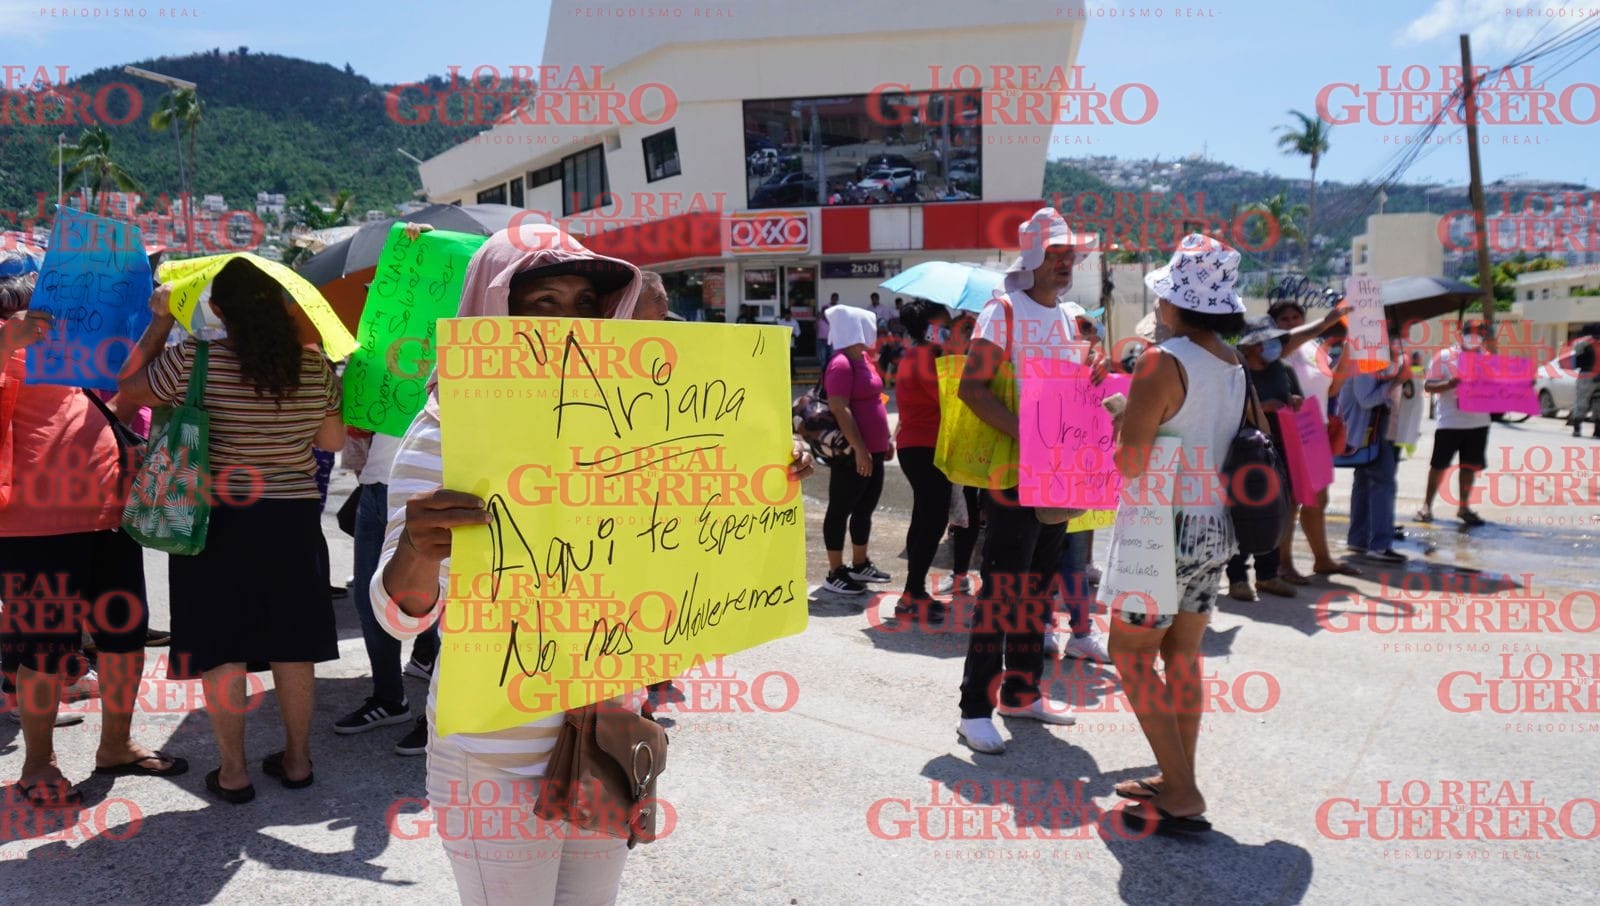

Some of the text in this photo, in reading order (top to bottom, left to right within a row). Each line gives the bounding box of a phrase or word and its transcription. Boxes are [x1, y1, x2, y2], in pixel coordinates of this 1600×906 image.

[732, 218, 806, 248] OXXO
[636, 491, 680, 553] te
[499, 600, 557, 687] No
[584, 609, 639, 662] nos
